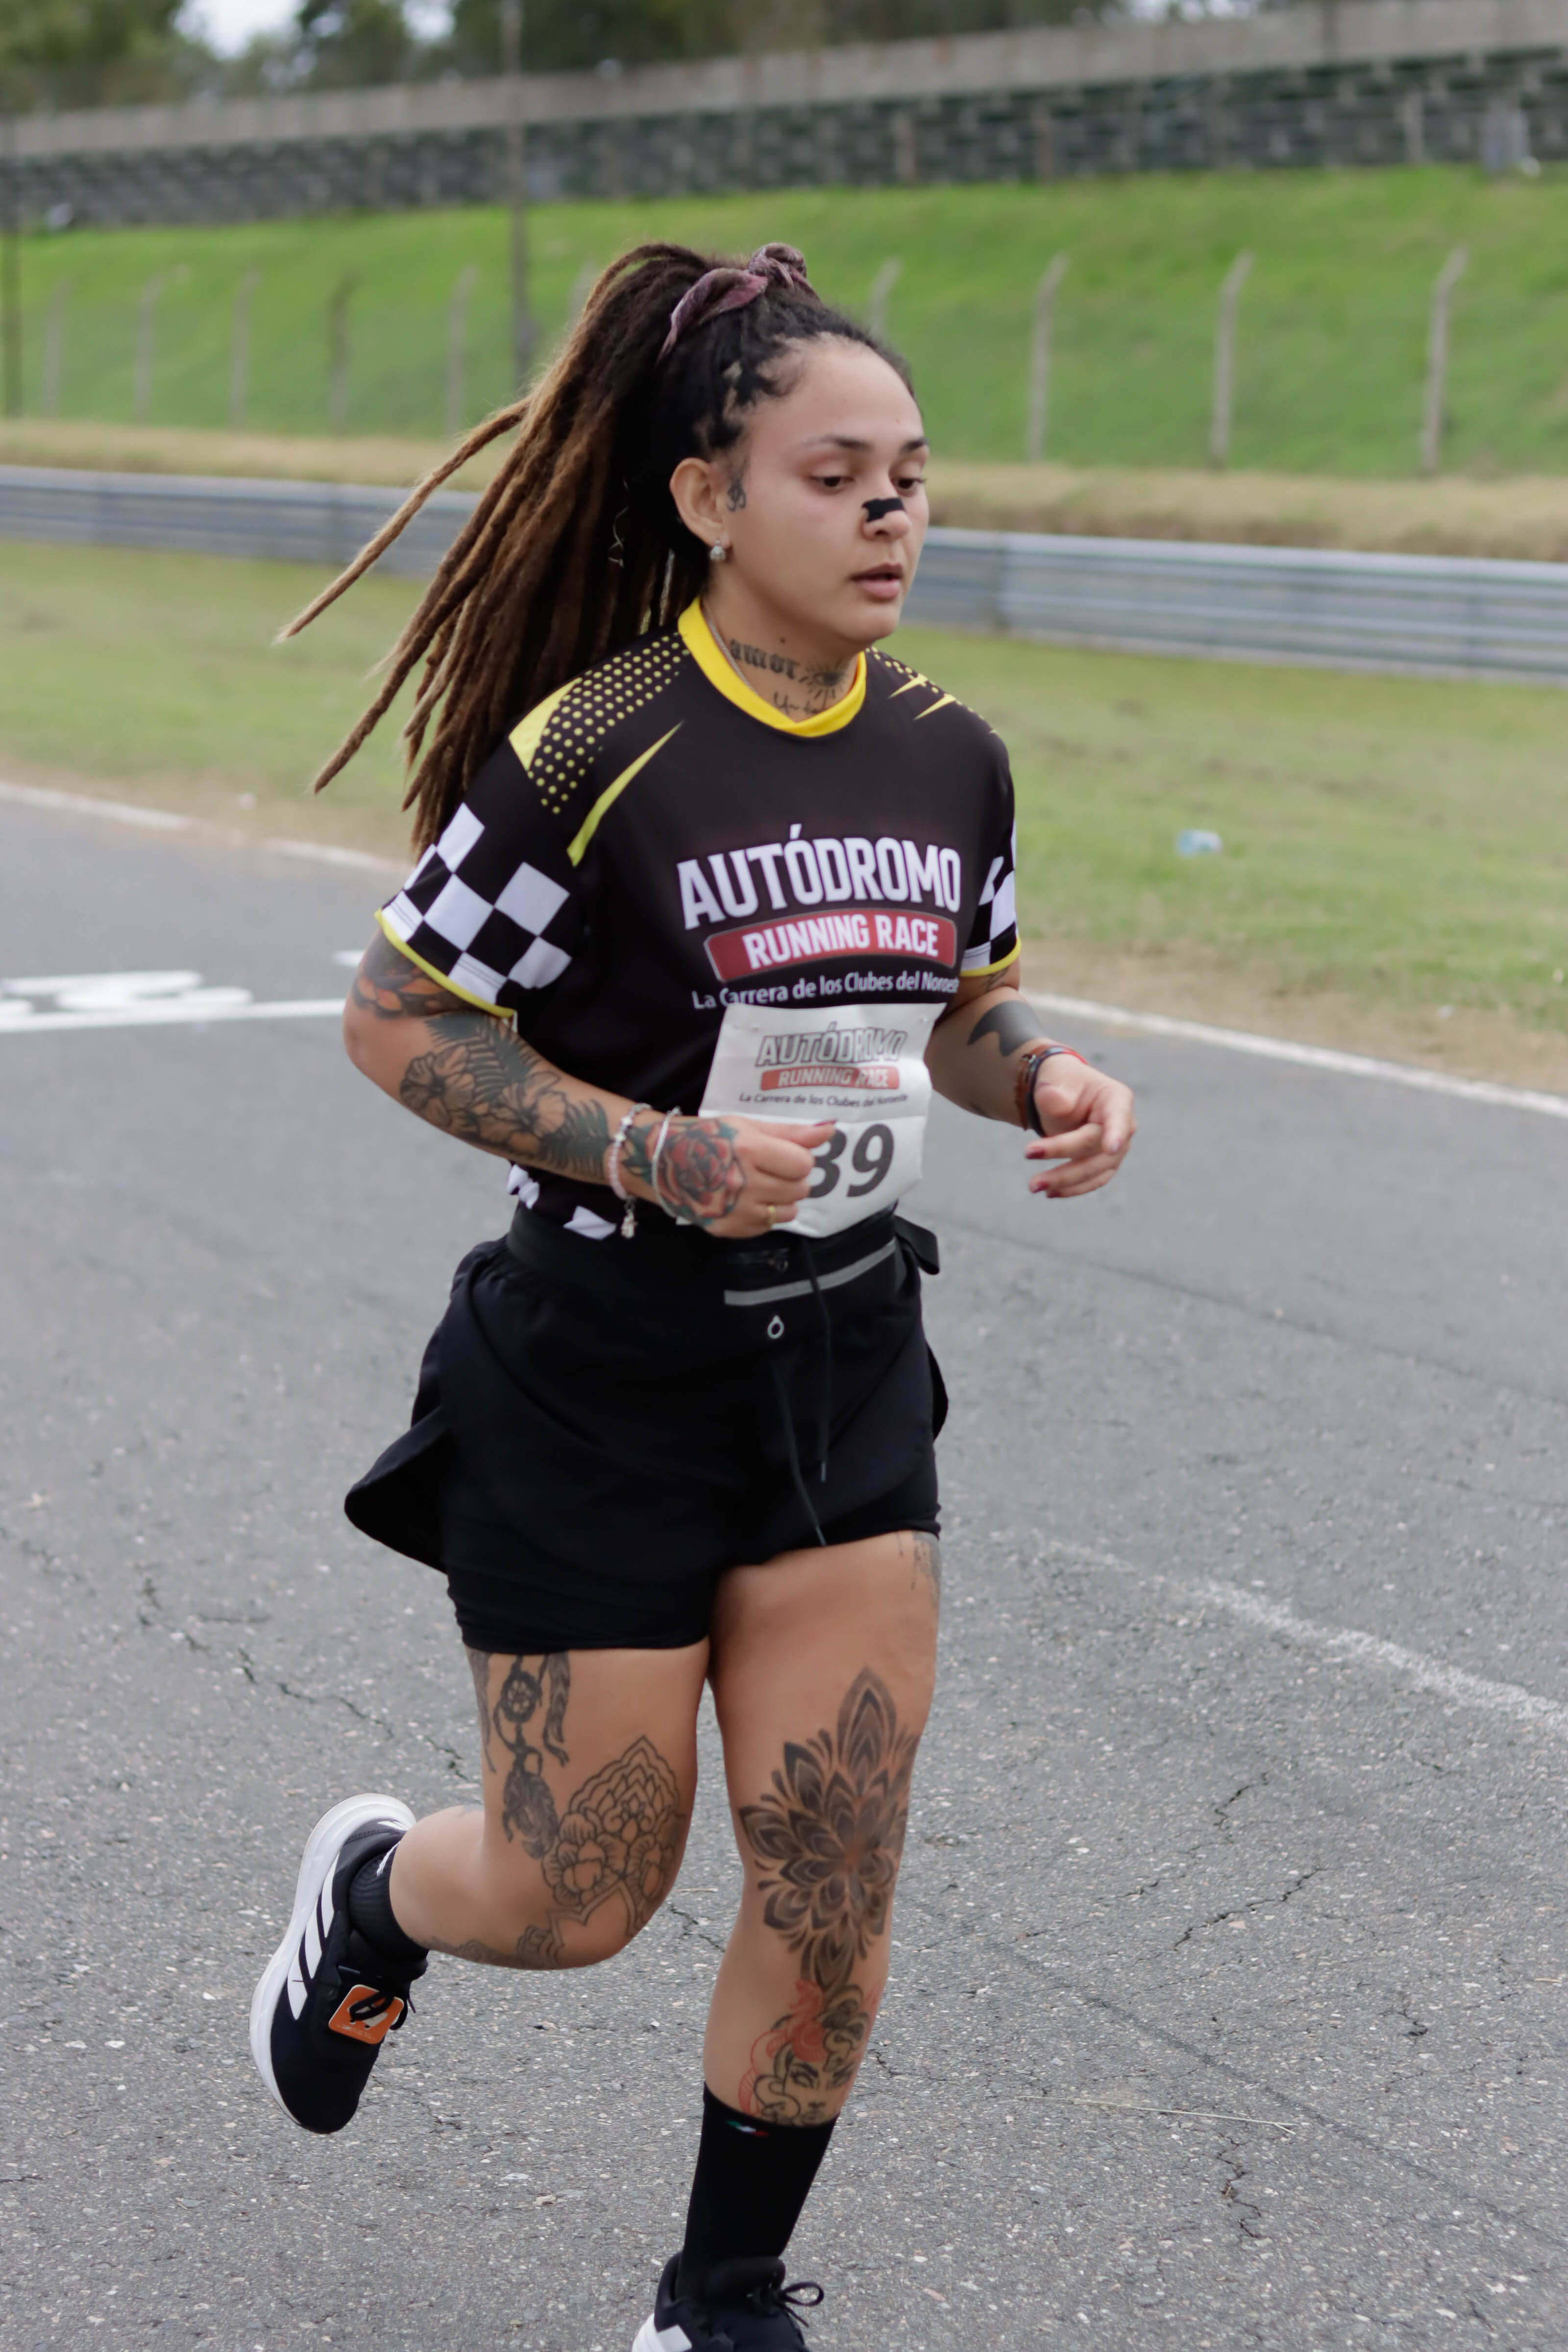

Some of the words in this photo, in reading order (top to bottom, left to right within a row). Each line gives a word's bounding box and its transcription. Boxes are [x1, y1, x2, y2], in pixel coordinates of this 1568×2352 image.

[676, 823, 960, 931] AUTÓDROMO
[742, 914, 870, 969] RUNNING
[874, 914, 939, 957] RACE
[691, 990, 717, 1009] La
[719, 985, 788, 1007] Carrera
[792, 977, 817, 999] de
[819, 975, 842, 996] los
[844, 970, 893, 993] Clubes
[896, 970, 920, 991] del
[755, 1021, 907, 1067] AUTÓDROMO
[739, 1093, 751, 1102] La
[754, 1093, 791, 1102] Carrera
[793, 1093, 806, 1103] de
[778, 1068, 854, 1087] RUNNING
